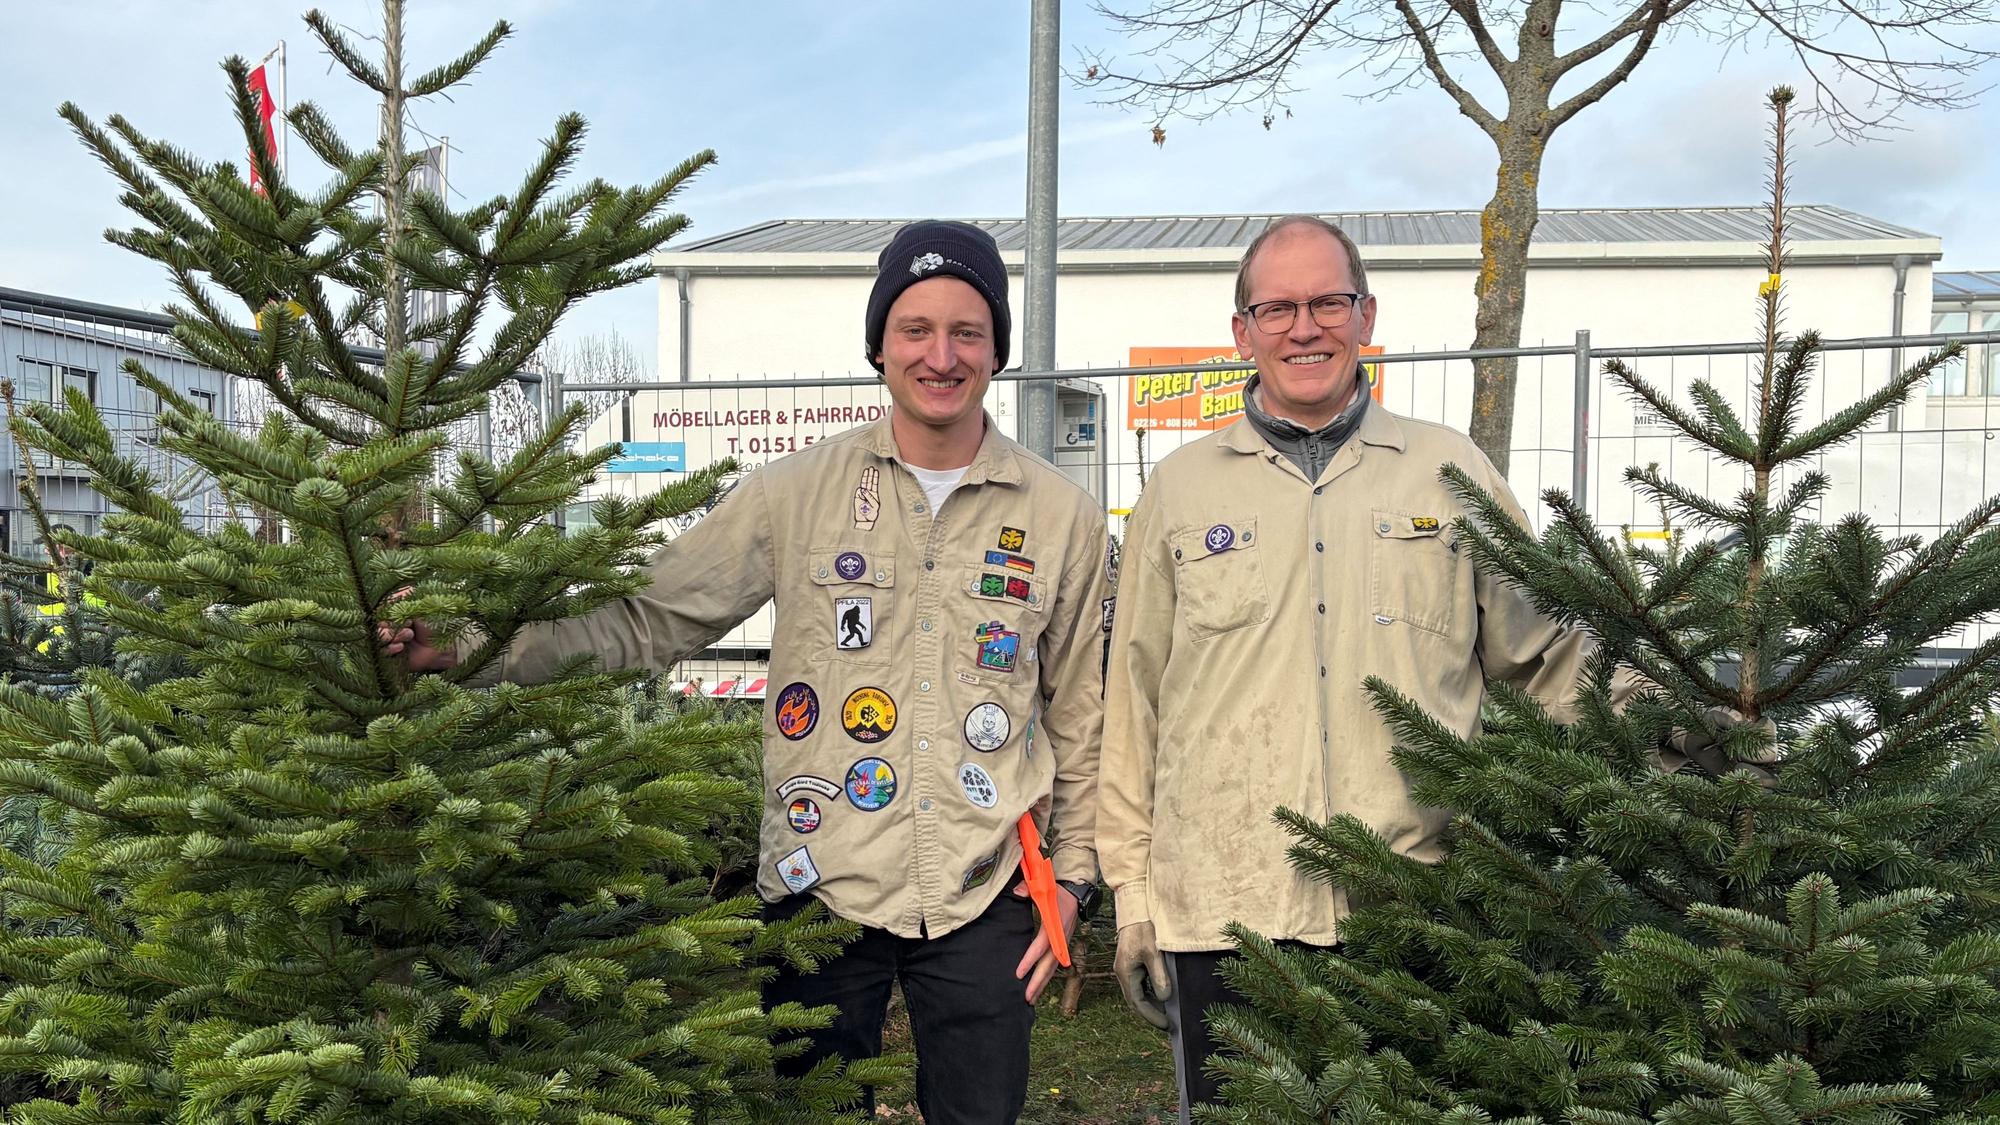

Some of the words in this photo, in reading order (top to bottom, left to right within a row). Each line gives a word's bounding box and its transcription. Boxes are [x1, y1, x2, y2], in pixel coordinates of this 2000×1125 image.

[1136, 372, 1197, 405] Peter
[653, 408, 771, 428] MÖBELLAGER
[776, 411, 788, 425] &
[727, 437, 744, 454] T.
[749, 436, 797, 453] 0151
[804, 435, 826, 445] 5
